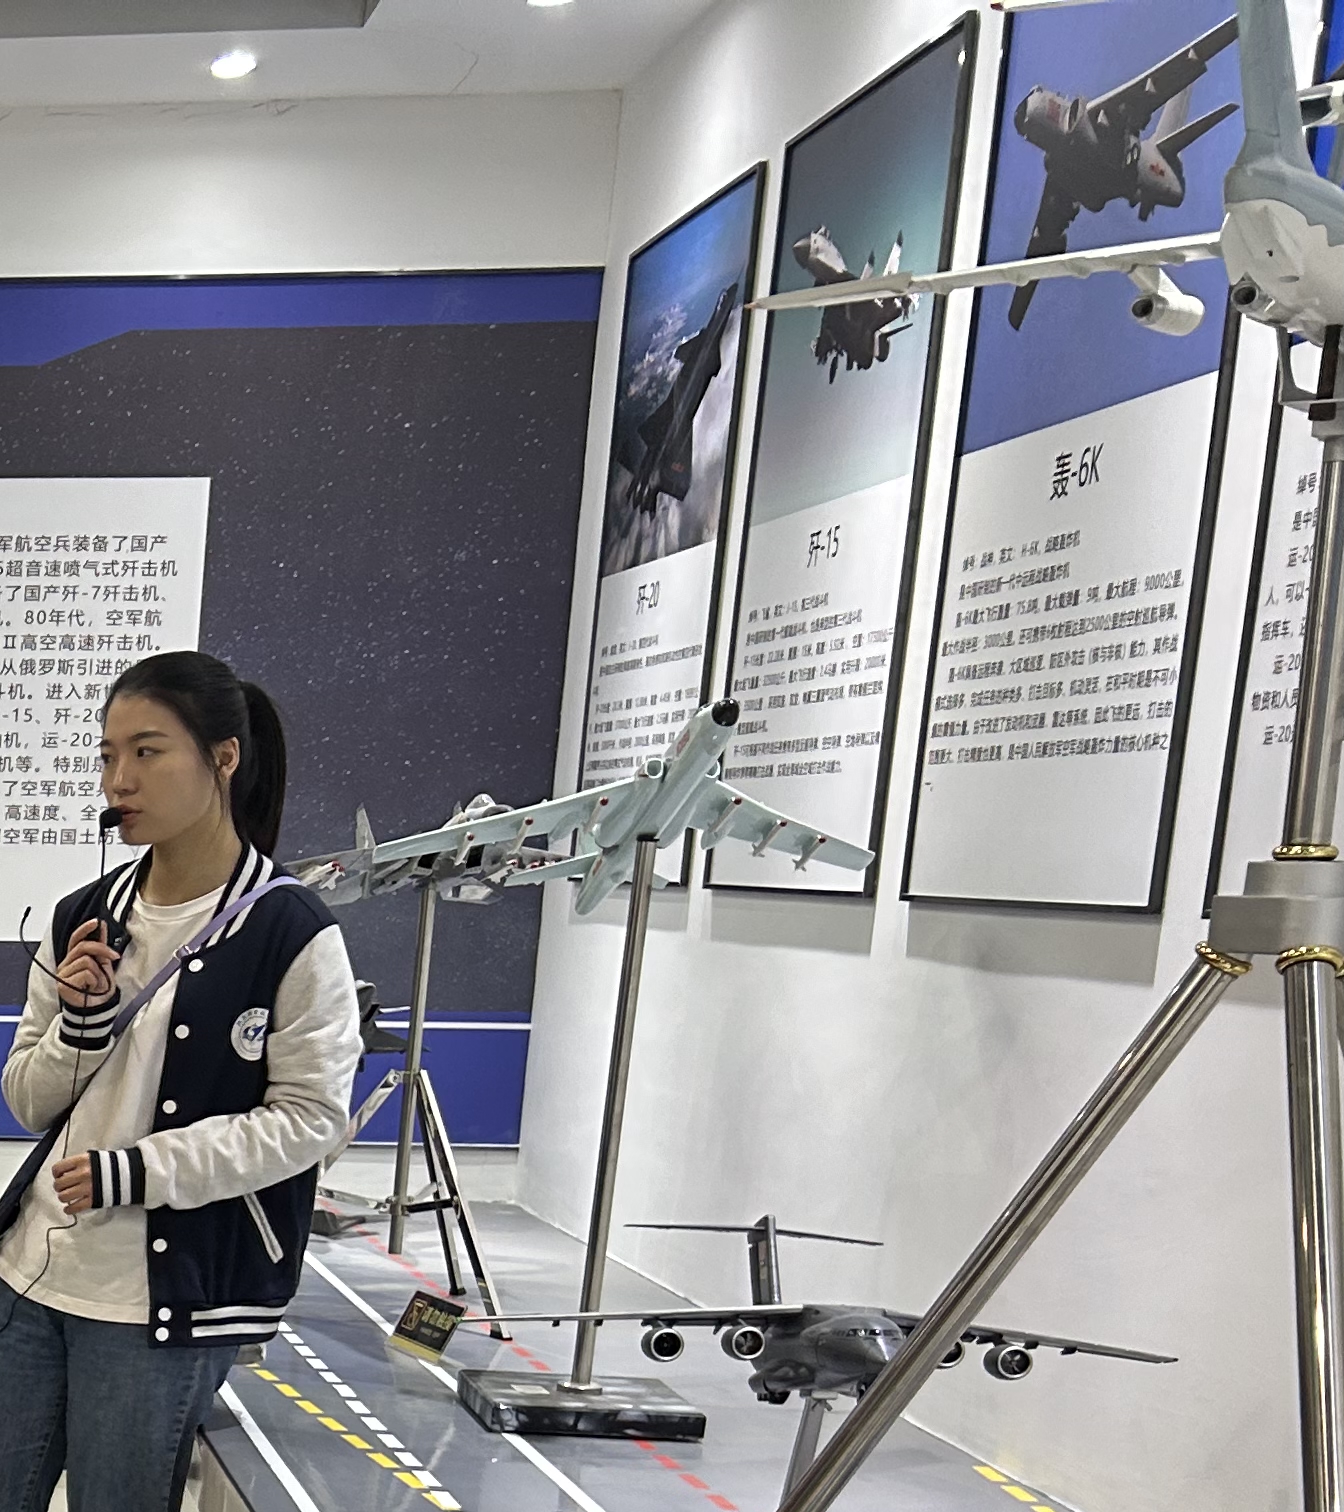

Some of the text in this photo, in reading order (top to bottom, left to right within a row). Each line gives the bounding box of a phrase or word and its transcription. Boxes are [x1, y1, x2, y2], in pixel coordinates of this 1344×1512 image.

[1050, 442, 1104, 500] 轰-6K
[807, 524, 841, 568] 歼-15
[636, 580, 660, 615] 歼-20
[1263, 724, 1294, 745] 运-20
